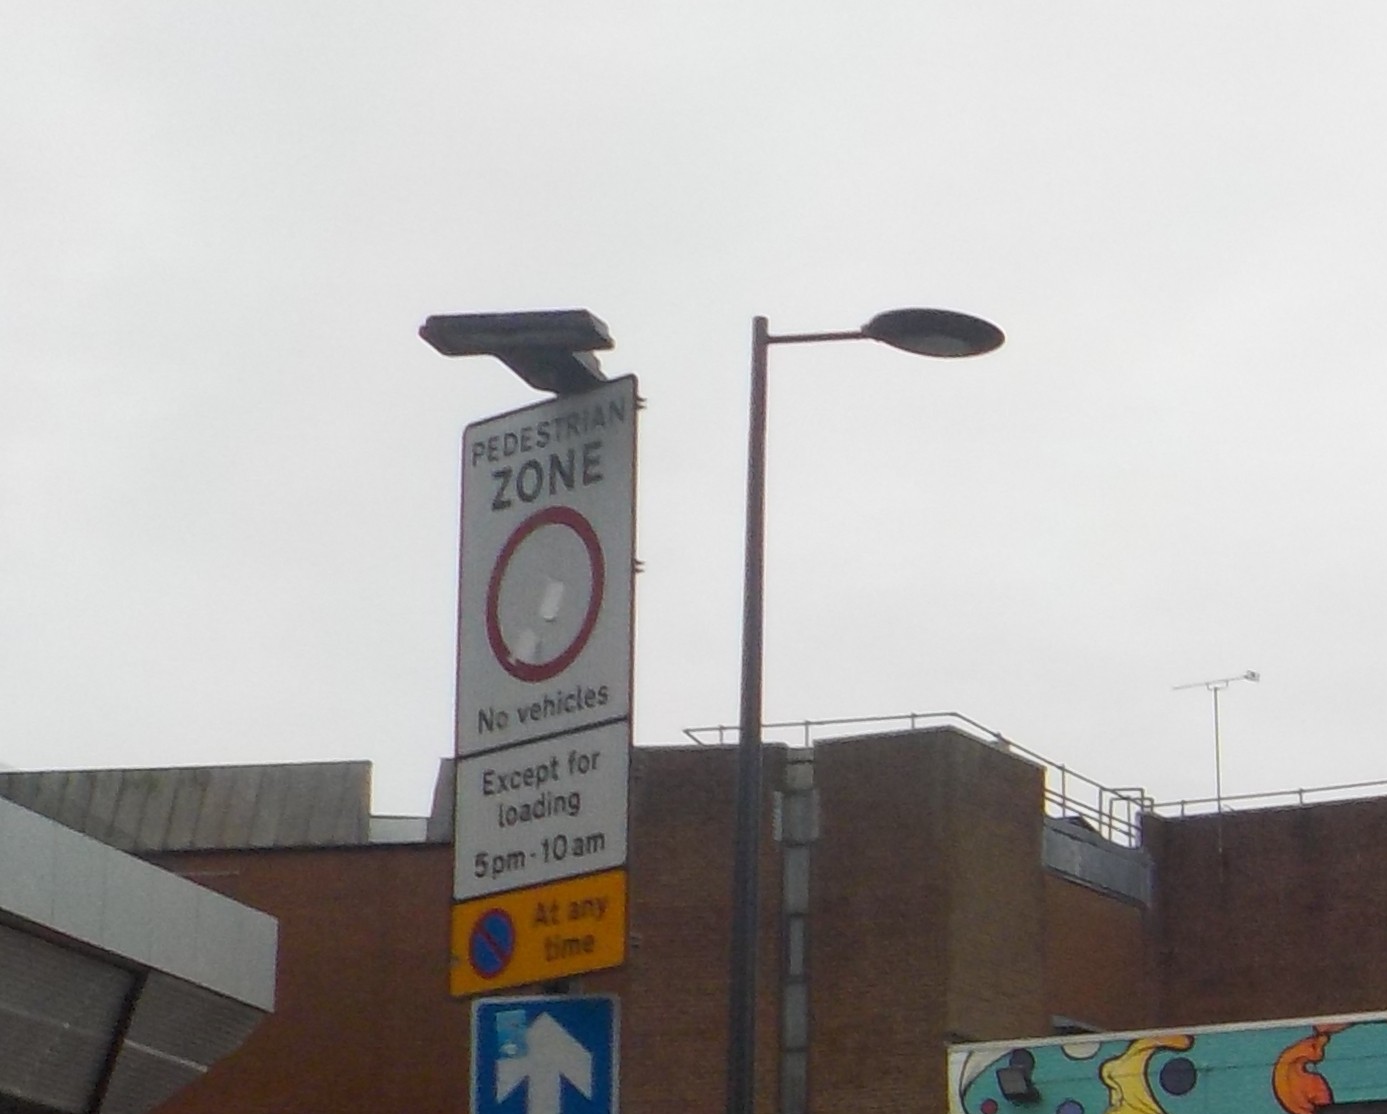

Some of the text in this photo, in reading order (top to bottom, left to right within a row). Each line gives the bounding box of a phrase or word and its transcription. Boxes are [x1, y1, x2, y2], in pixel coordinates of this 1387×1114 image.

[471, 396, 626, 467] PEDESTRIAN
[490, 440, 604, 512] ZONE
[477, 683, 609, 735] No vehicles
[481, 749, 602, 797] Except for
[496, 790, 581, 829] loading
[535, 896, 607, 926] At any
[545, 933, 596, 961] time
